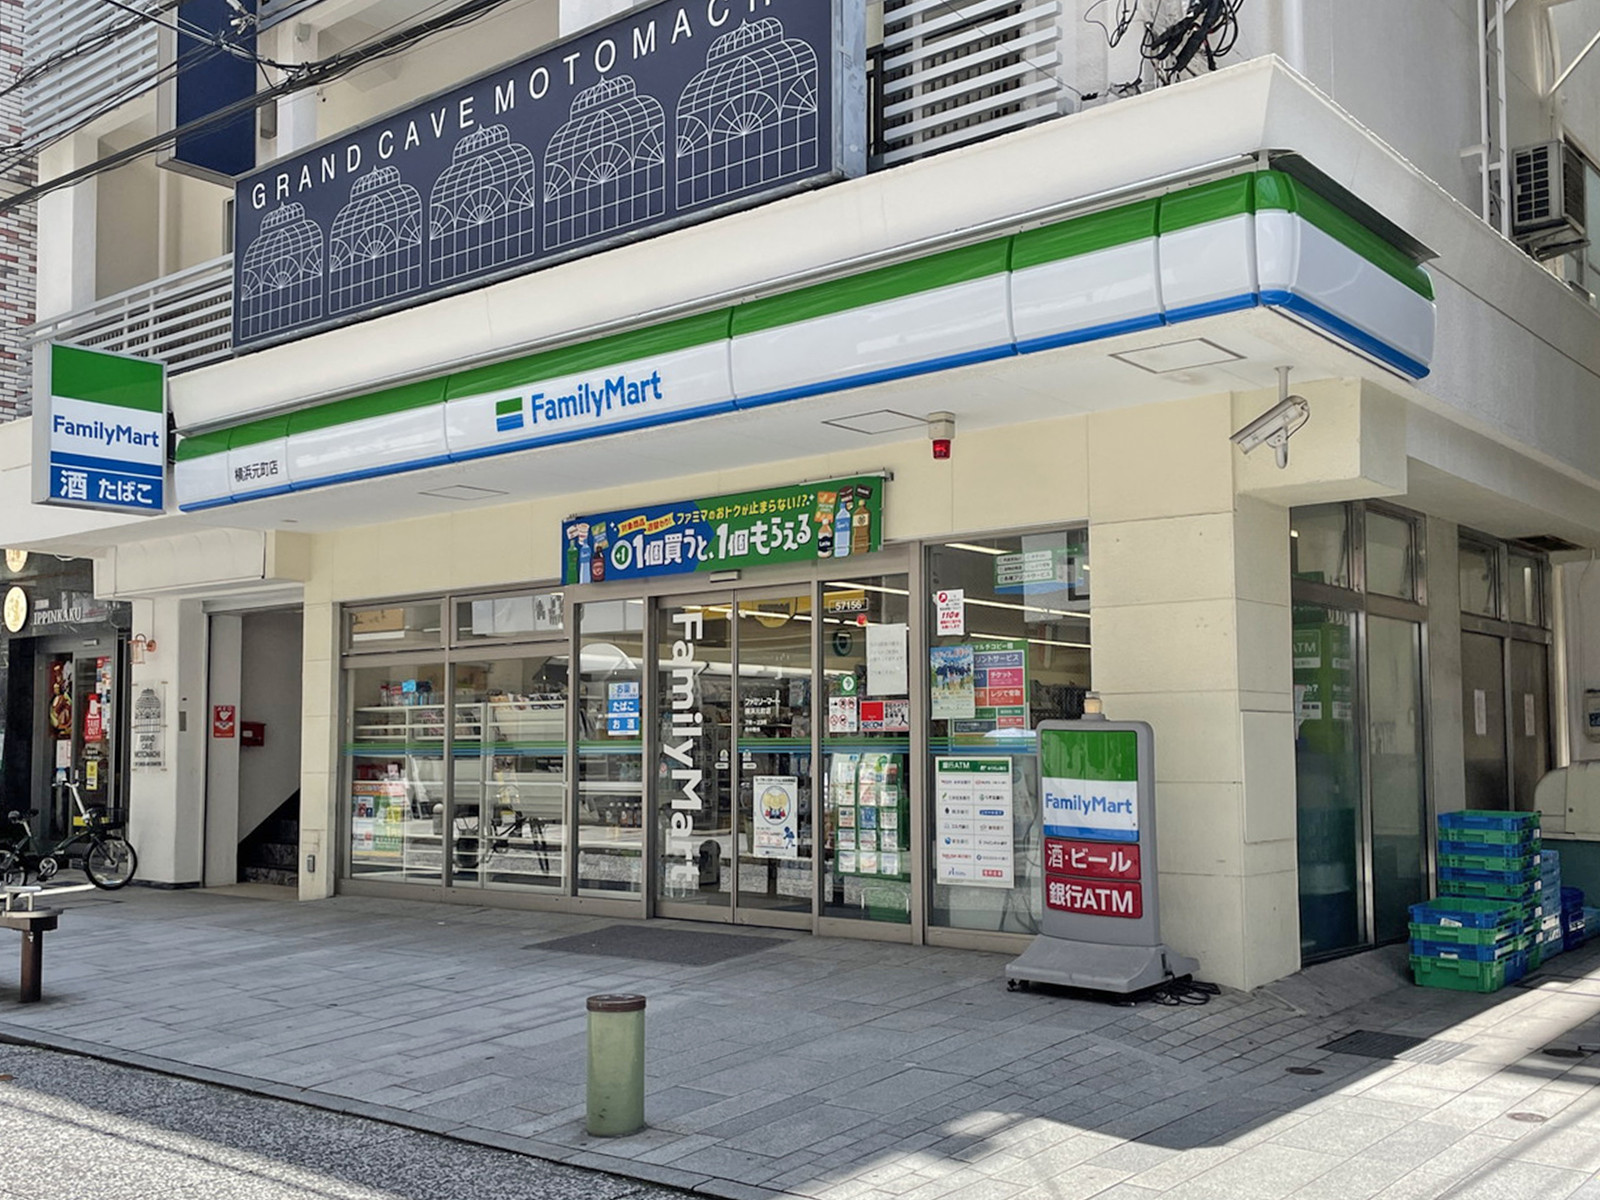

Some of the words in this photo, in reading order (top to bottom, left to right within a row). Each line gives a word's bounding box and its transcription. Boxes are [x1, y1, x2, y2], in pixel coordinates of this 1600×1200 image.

[252, 145, 363, 210] GRAND
[378, 96, 476, 161] CAVE
[531, 370, 663, 424] FamilyMart
[53, 414, 160, 448] FamilyMart
[234, 459, 279, 483] 横浜元町店
[59, 469, 88, 501] 酒
[98, 476, 153, 505] たばこ
[34, 607, 82, 625] IPPINKAKU
[835, 599, 862, 611] 57156
[991, 671, 1013, 680] チケット
[613, 701, 635, 712] たばこ
[861, 721, 884, 730] SECOM
[663, 612, 703, 883] FamilyMart
[1045, 792, 1133, 815] FamilyMart
[1049, 880, 1133, 914] 銀行ATM
